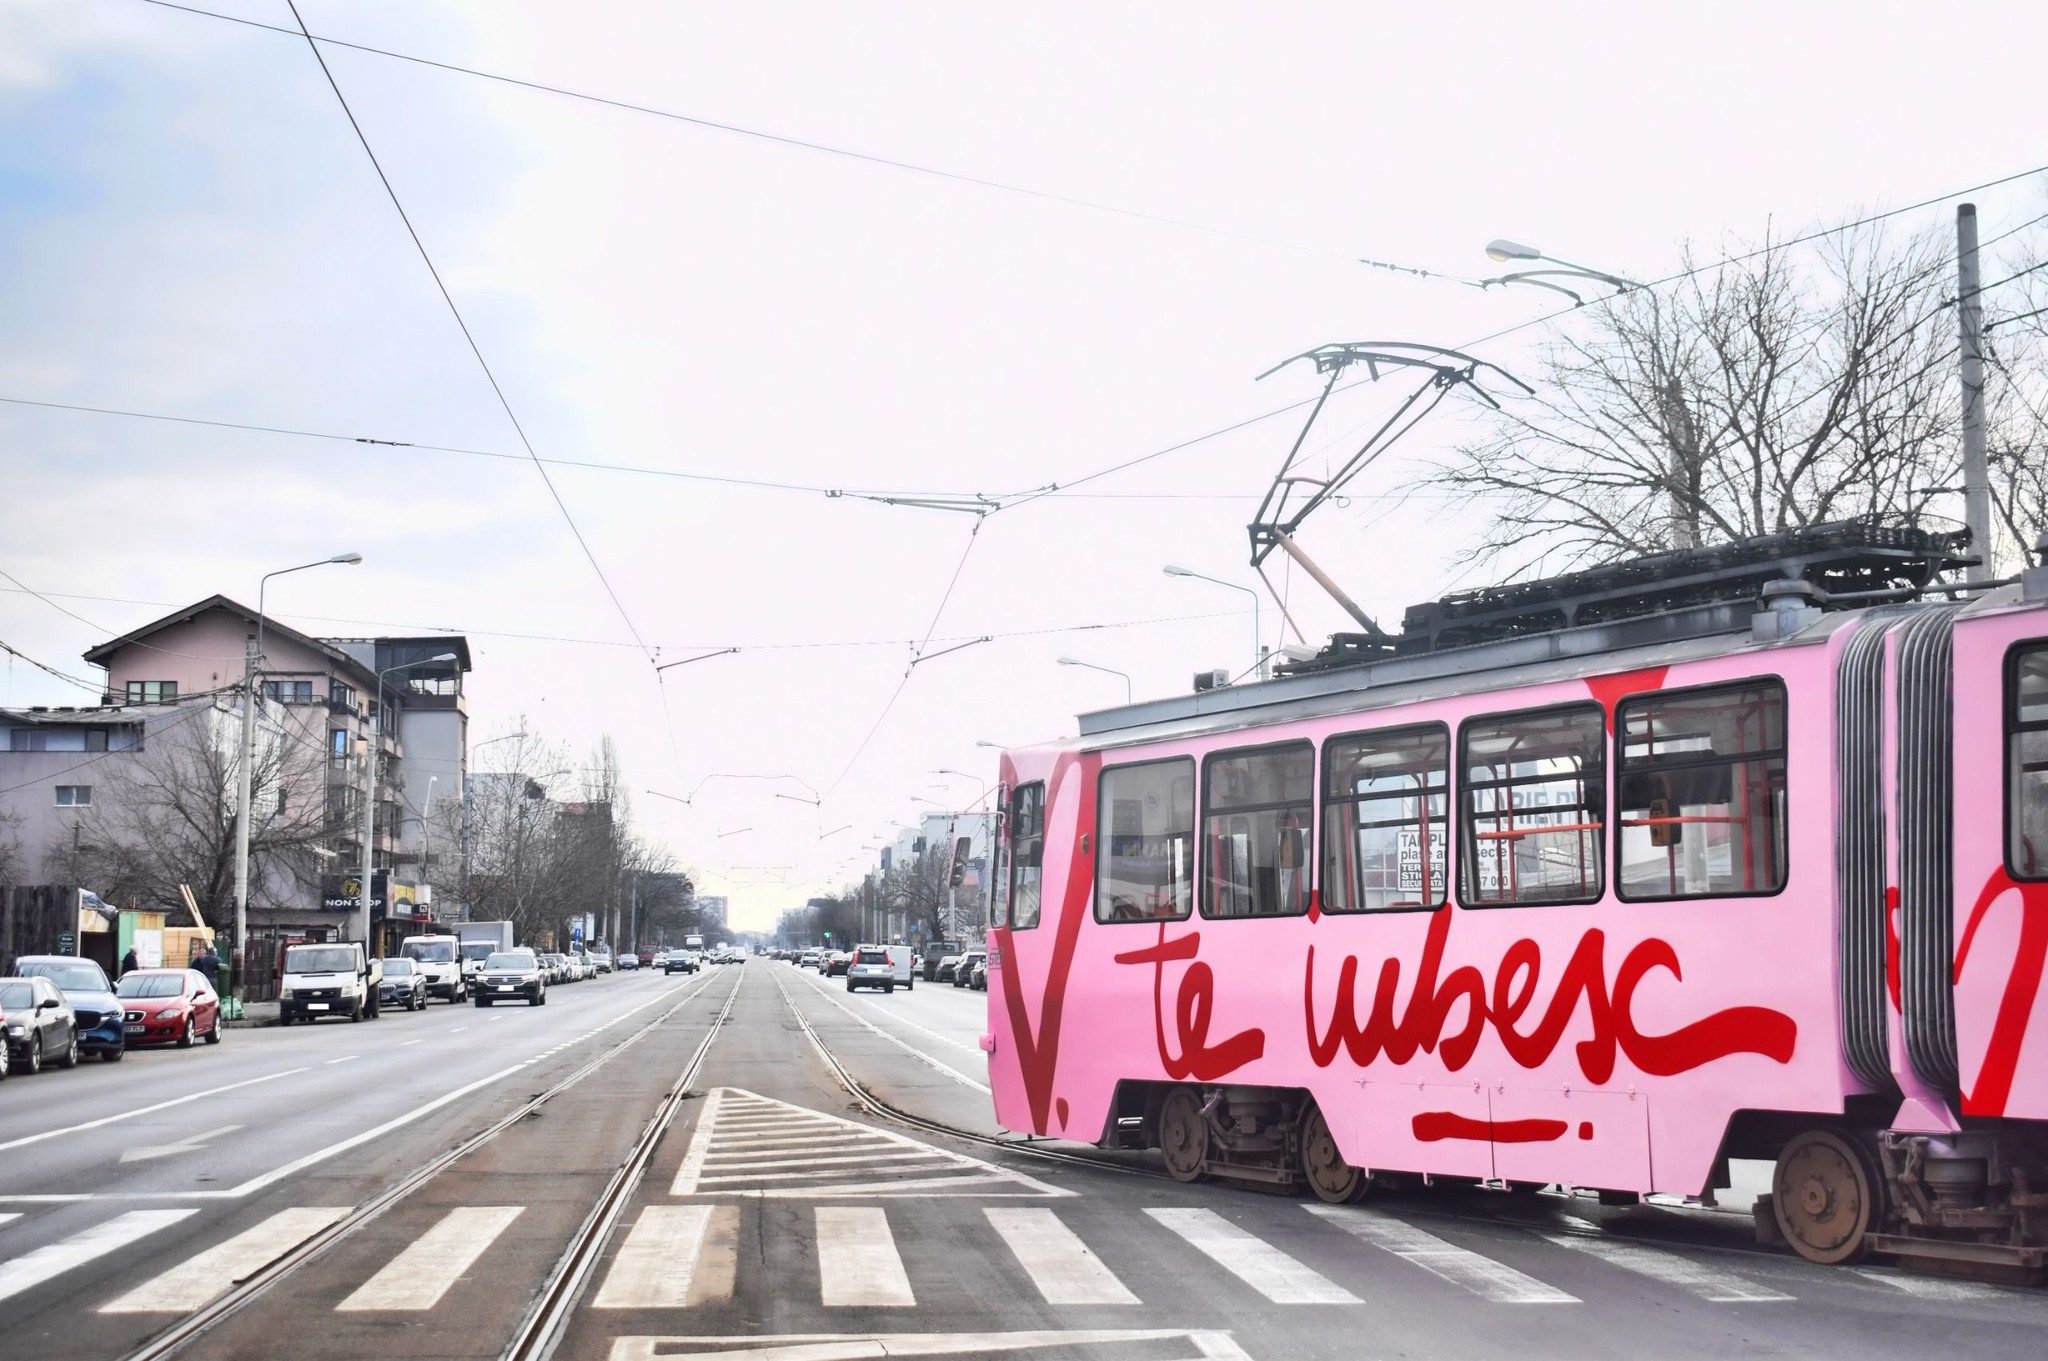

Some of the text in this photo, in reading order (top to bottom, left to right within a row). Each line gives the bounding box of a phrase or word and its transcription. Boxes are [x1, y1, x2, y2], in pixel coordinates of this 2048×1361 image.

[1401, 864, 1442, 872] TERSE
[1401, 872, 1442, 880] STIA
[325, 899, 382, 907] NON SOP
[1304, 892, 1797, 1085] iubesc
